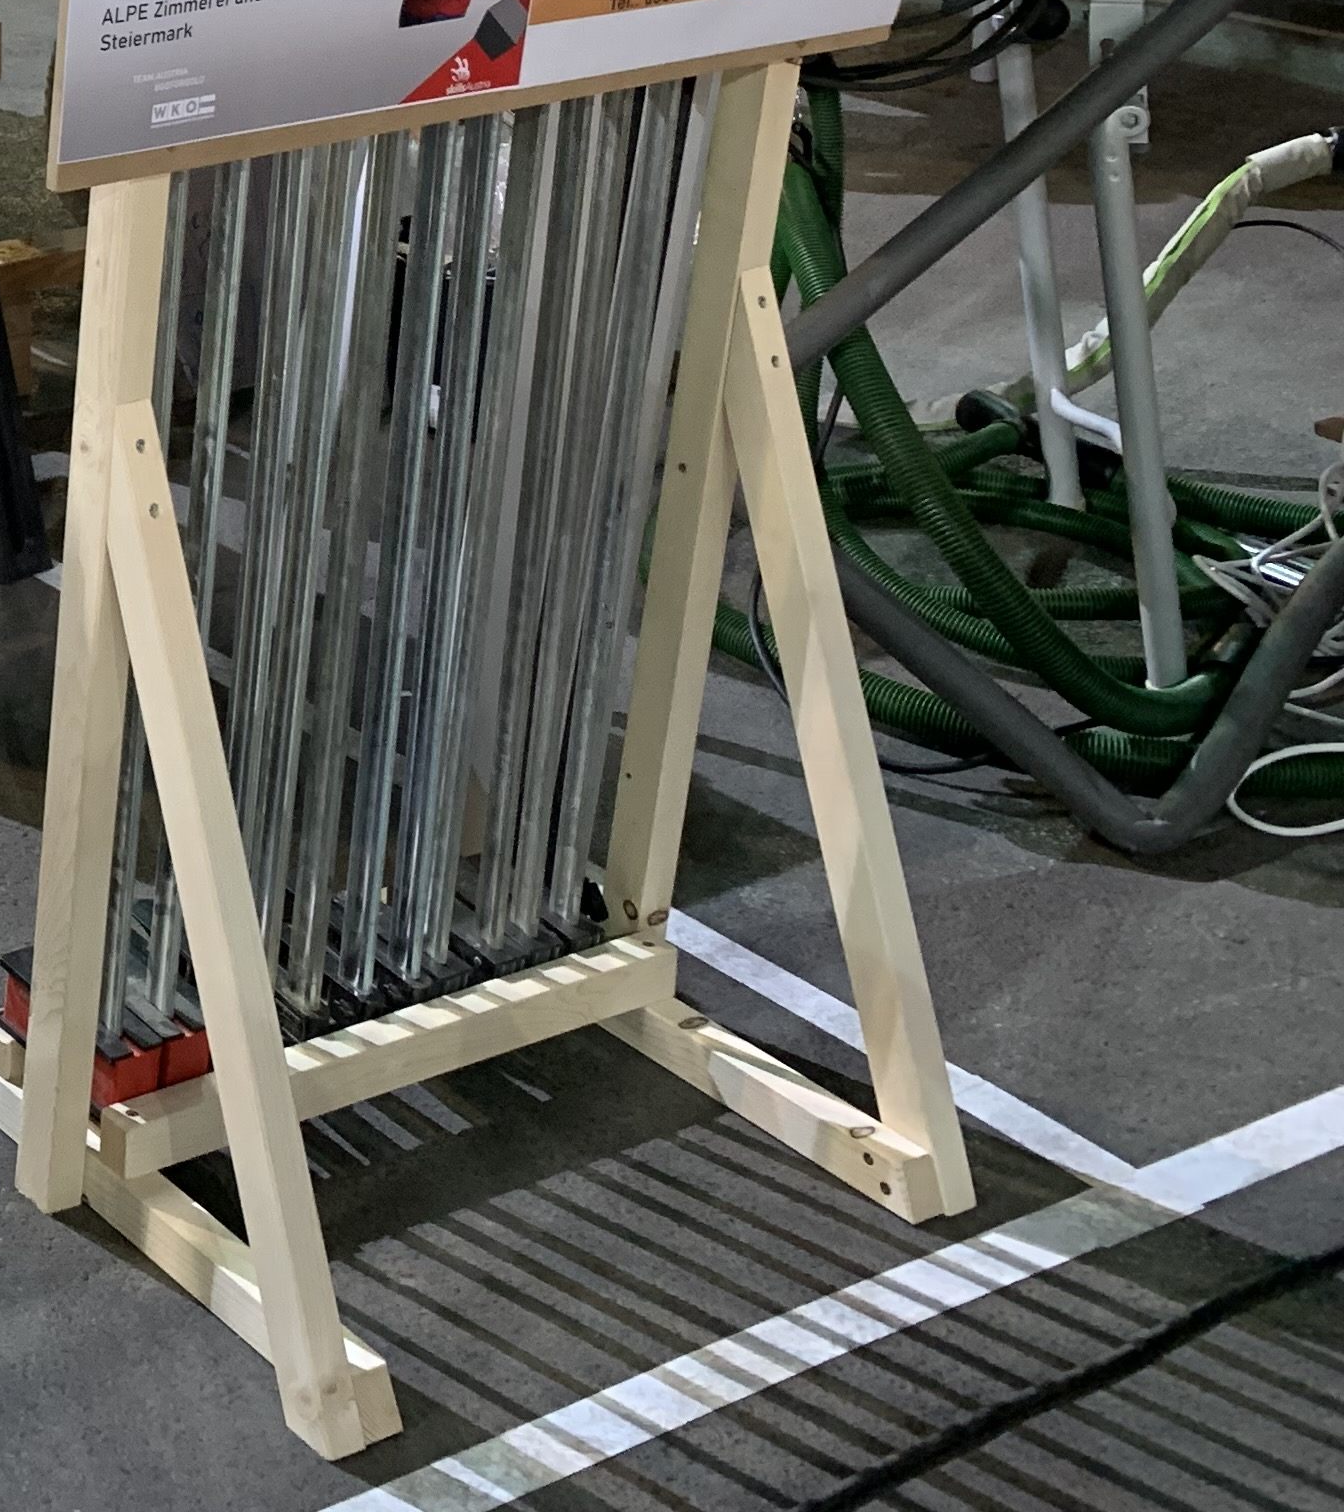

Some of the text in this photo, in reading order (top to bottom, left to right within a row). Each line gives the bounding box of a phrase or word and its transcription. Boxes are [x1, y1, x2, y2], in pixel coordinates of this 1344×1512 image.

[101, 4, 149, 26] ALPE
[100, 23, 193, 51] Steiermark
[153, 99, 197, 120] WKO
